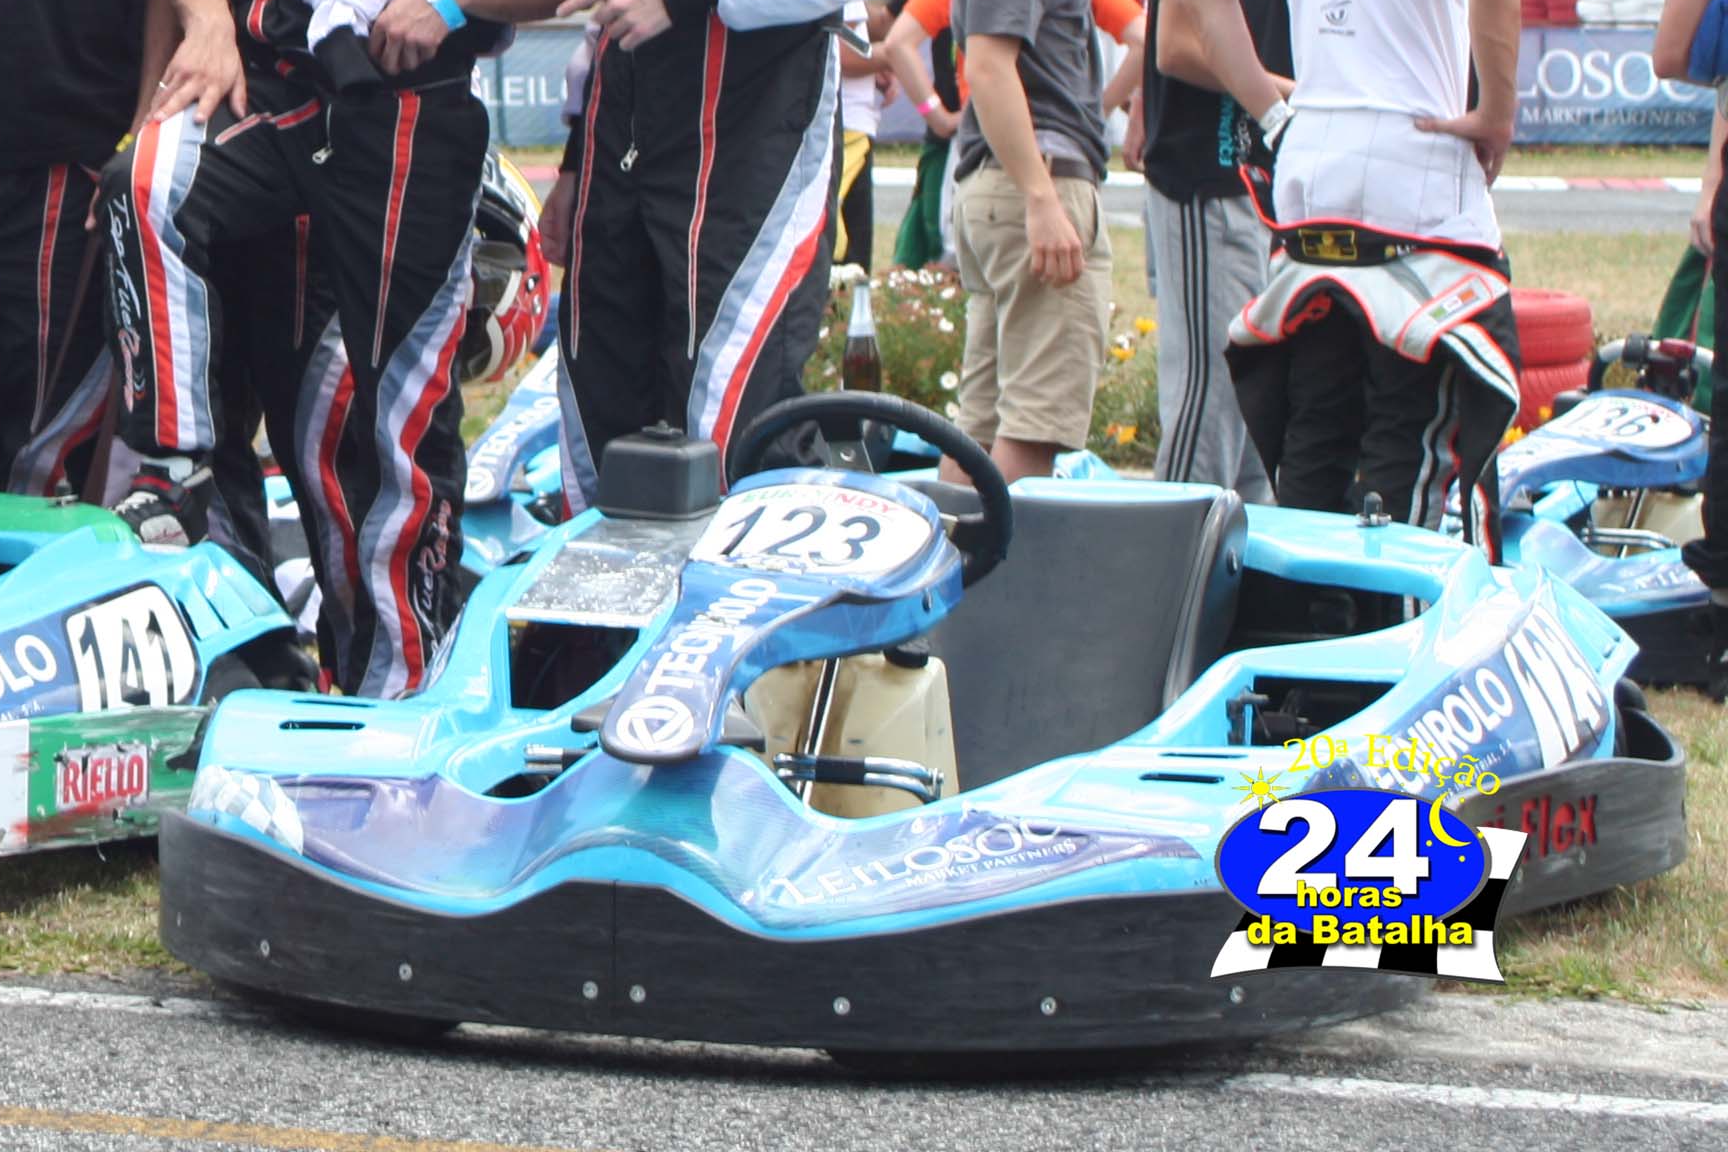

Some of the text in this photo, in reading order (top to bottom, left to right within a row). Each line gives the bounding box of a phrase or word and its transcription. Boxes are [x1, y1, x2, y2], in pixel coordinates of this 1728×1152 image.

[719, 504, 882, 567] 123
[78, 609, 175, 711] 141
[62, 753, 145, 805] RIELLO
